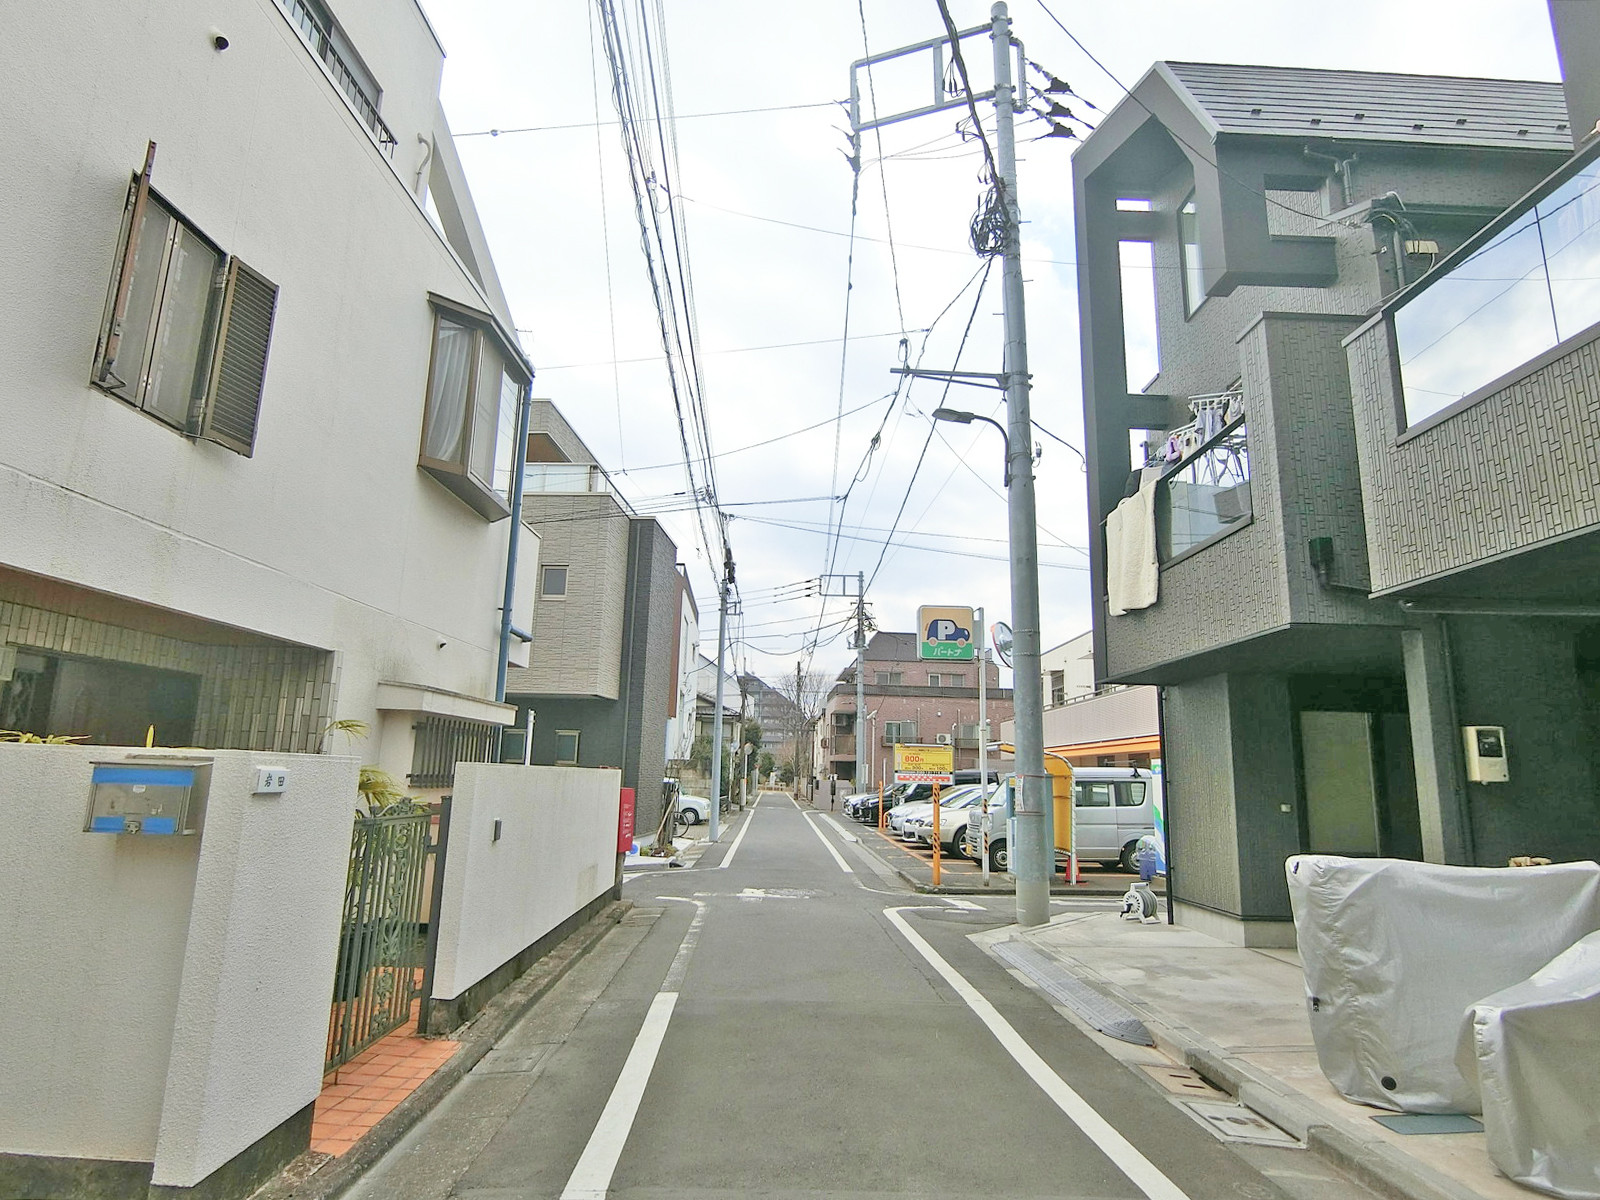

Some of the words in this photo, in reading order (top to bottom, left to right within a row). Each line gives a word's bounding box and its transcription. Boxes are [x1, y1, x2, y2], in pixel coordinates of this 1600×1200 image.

[938, 621, 955, 640] P
[933, 646, 962, 656] パートナ
